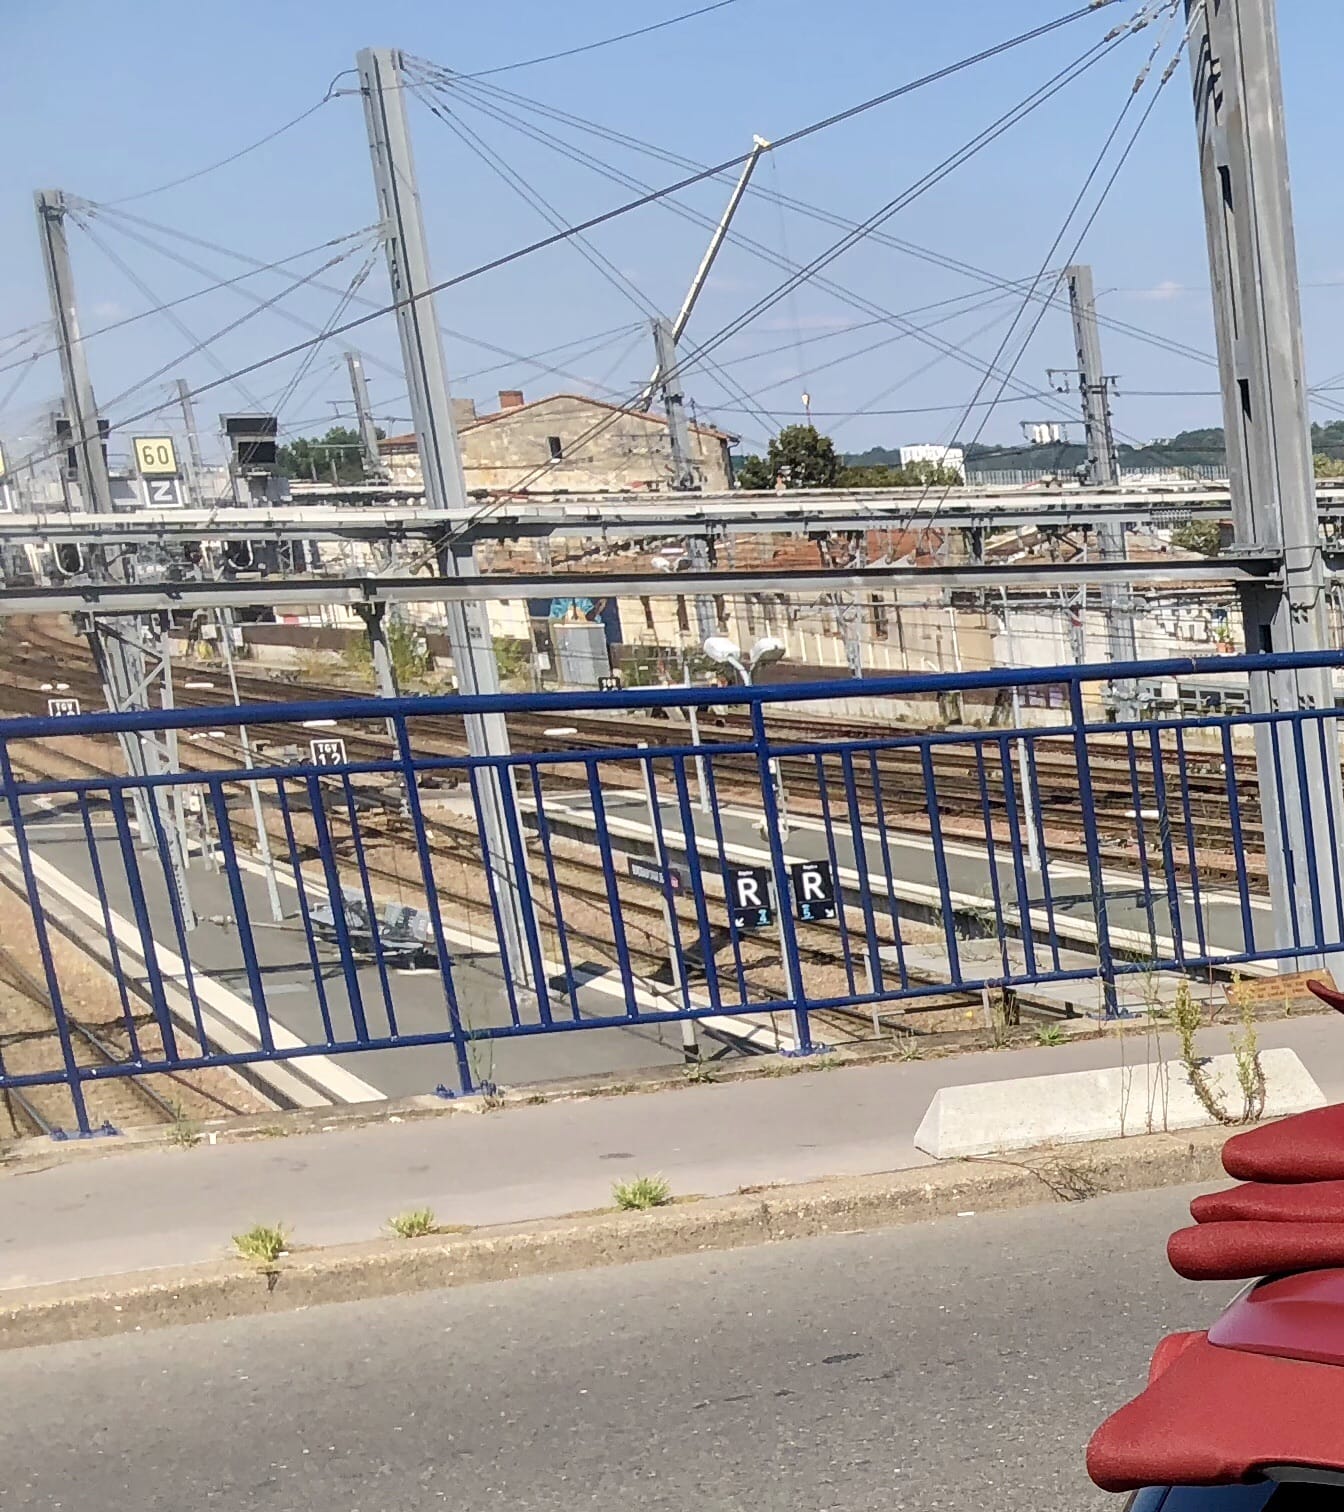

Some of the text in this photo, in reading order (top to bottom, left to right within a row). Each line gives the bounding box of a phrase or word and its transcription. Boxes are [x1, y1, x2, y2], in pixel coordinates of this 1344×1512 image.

[142, 445, 170, 466] 60
[151, 481, 173, 501] Z
[55, 701, 73, 712] TGV
[317, 743, 338, 753] TGV
[737, 877, 762, 908] R
[802, 871, 825, 901] R
